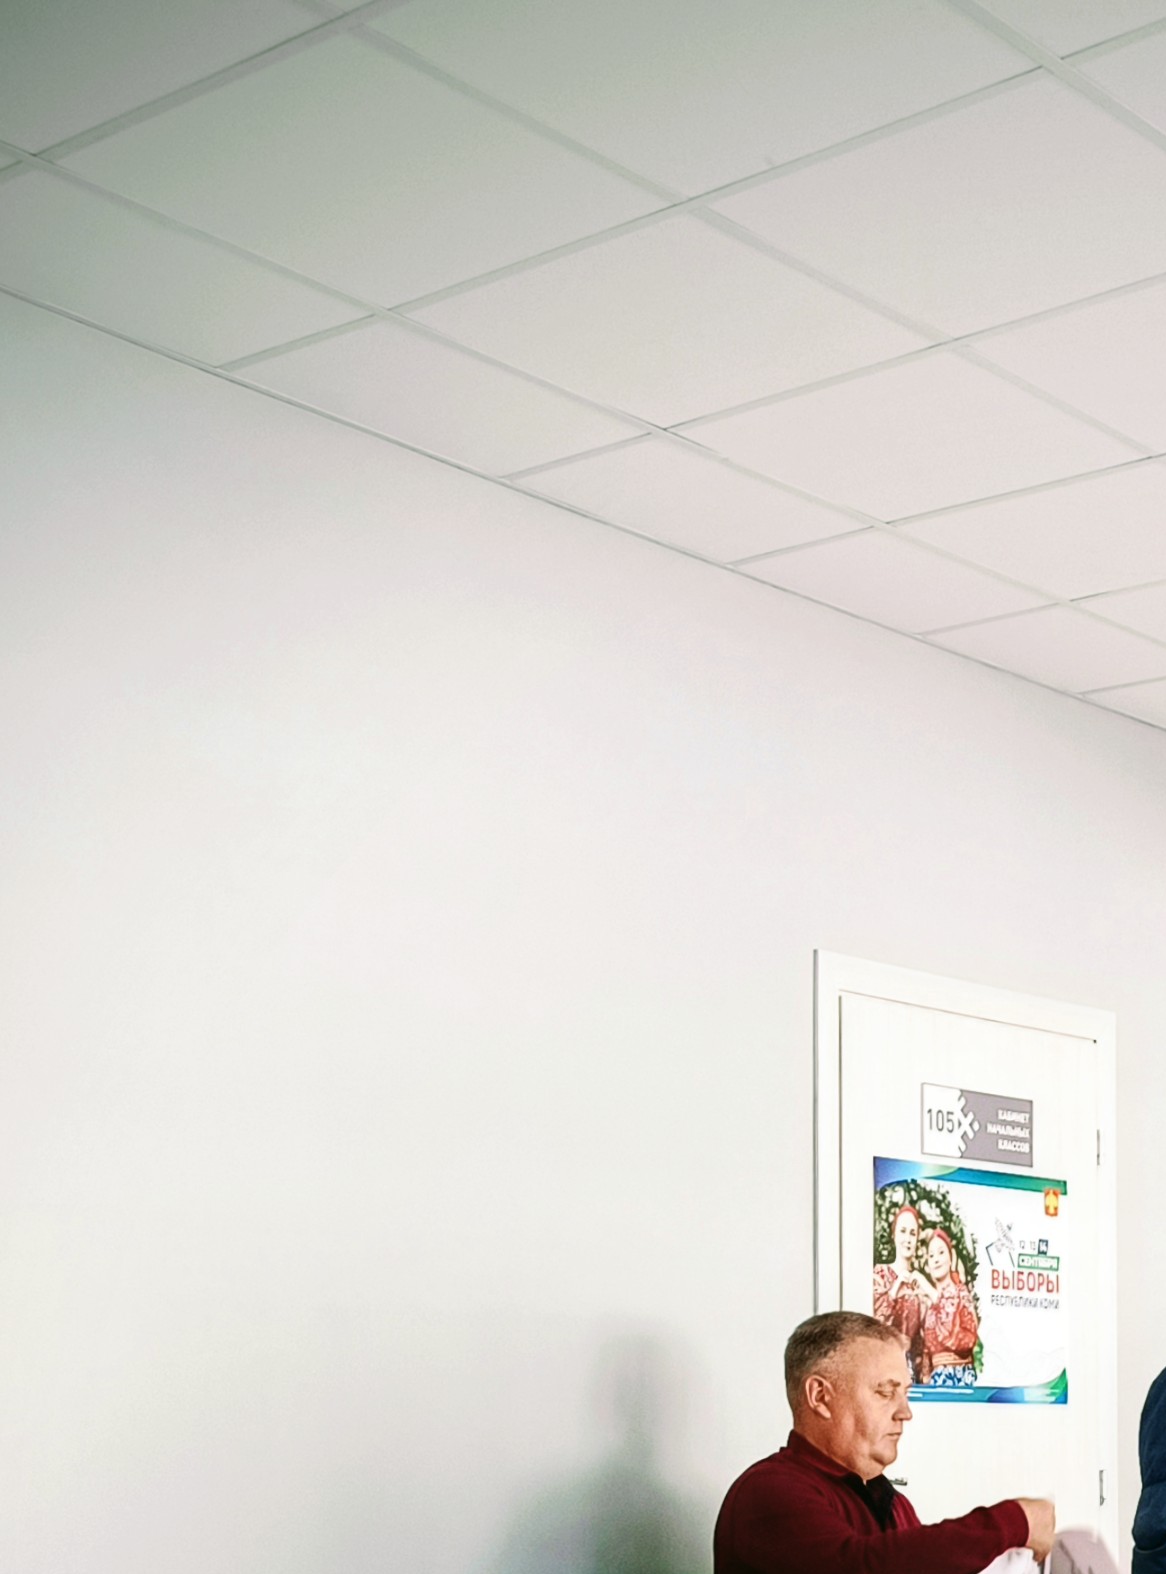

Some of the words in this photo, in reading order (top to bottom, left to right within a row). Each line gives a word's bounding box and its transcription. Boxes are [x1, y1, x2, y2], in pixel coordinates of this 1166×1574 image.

[927, 1108, 955, 1133] 105
[986, 1122, 1030, 1138] НАЧАЛЬНЫХ
[997, 1138, 1030, 1153] КЛАССОВ
[991, 1268, 1060, 1294] ВЫБОРЫ
